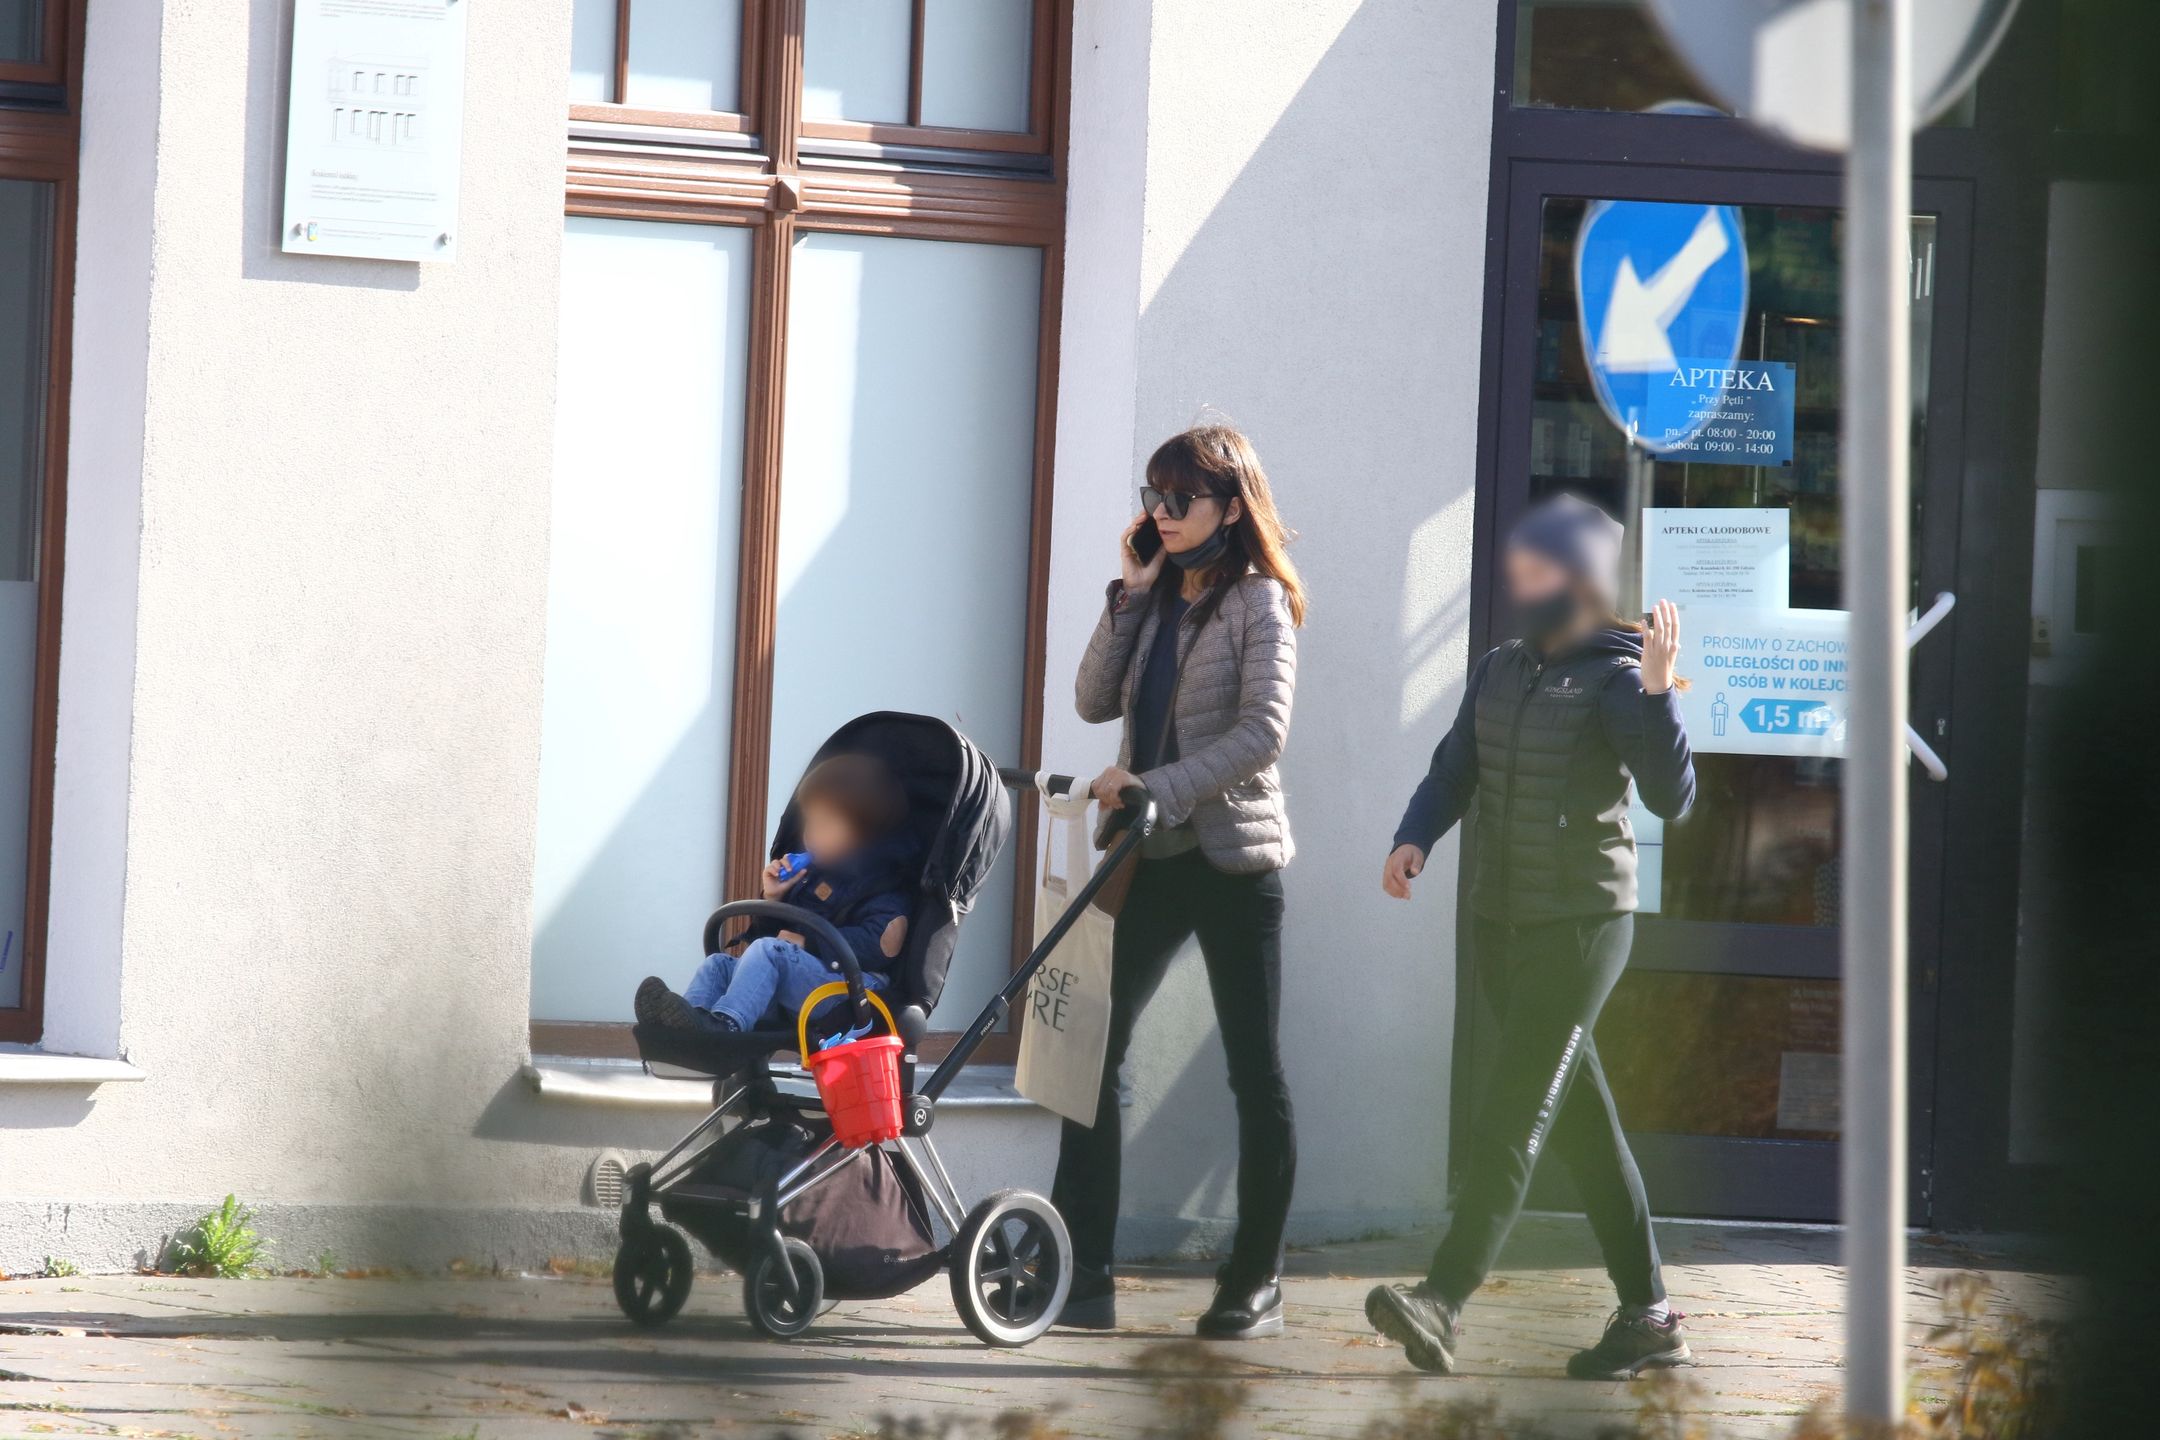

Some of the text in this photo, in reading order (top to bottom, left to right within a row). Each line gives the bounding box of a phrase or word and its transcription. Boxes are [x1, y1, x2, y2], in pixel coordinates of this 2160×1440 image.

[1669, 367, 1775, 391] APTEKA
[1698, 394, 1719, 406] Przy
[1688, 410, 1754, 423] zapraszamy:
[1665, 428, 1681, 438] pn.
[1707, 427, 1737, 438] 08:00
[1746, 429, 1776, 441] 20:00
[1666, 440, 1700, 451] sobota
[1705, 441, 1735, 452] 09:00
[1745, 442, 1774, 454] 14:00
[1662, 526, 1698, 535] APTEKI
[1703, 635, 1768, 650] PROSIMY
[1771, 638, 1783, 652] O
[1704, 655, 1794, 671] ODLEGŁOŚCI
[1798, 659, 1819, 672] OD
[1728, 673, 1768, 689] OSÓB
[1772, 677, 1786, 689] W
[1754, 704, 1790, 732] 1,5
[1543, 1024, 1583, 1108] ABERCROMBIE
